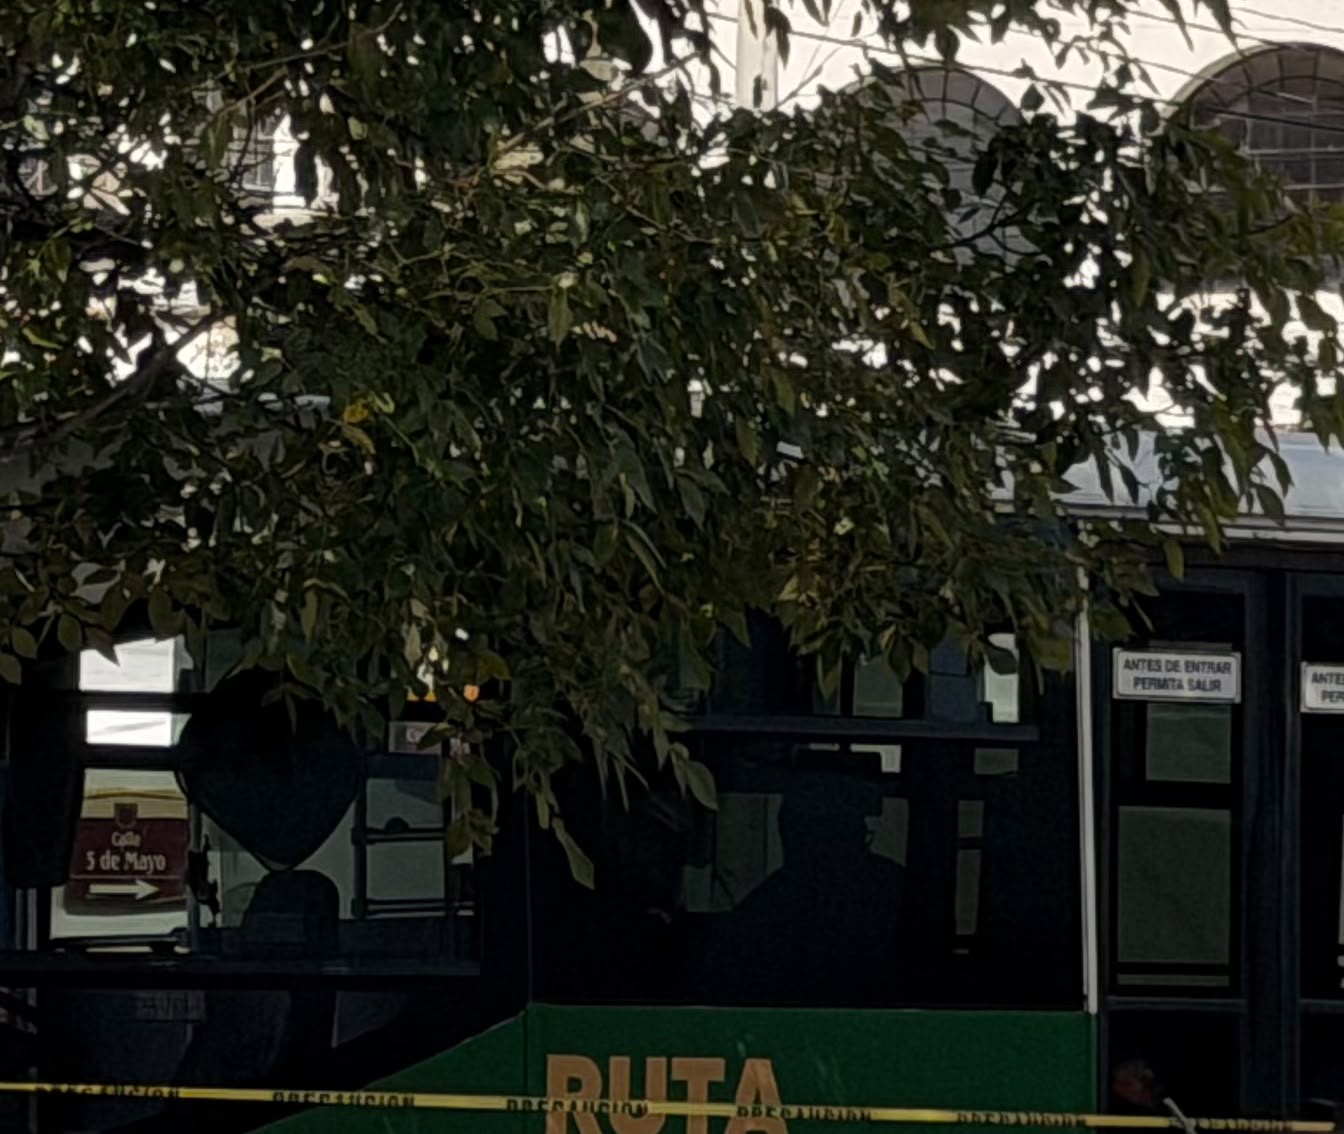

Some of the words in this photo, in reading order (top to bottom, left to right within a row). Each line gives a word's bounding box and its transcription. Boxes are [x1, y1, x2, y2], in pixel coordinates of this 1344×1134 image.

[1123, 658, 1161, 672] ANTES
[1164, 659, 1181, 672] DE
[1184, 660, 1232, 675] ENTRAR
[1133, 677, 1183, 690] PERMITA
[1187, 678, 1221, 691] SALIR
[111, 830, 142, 847] Calle
[86, 851, 96, 871] 5
[100, 851, 119, 871] de
[122, 852, 167, 874] Mayo
